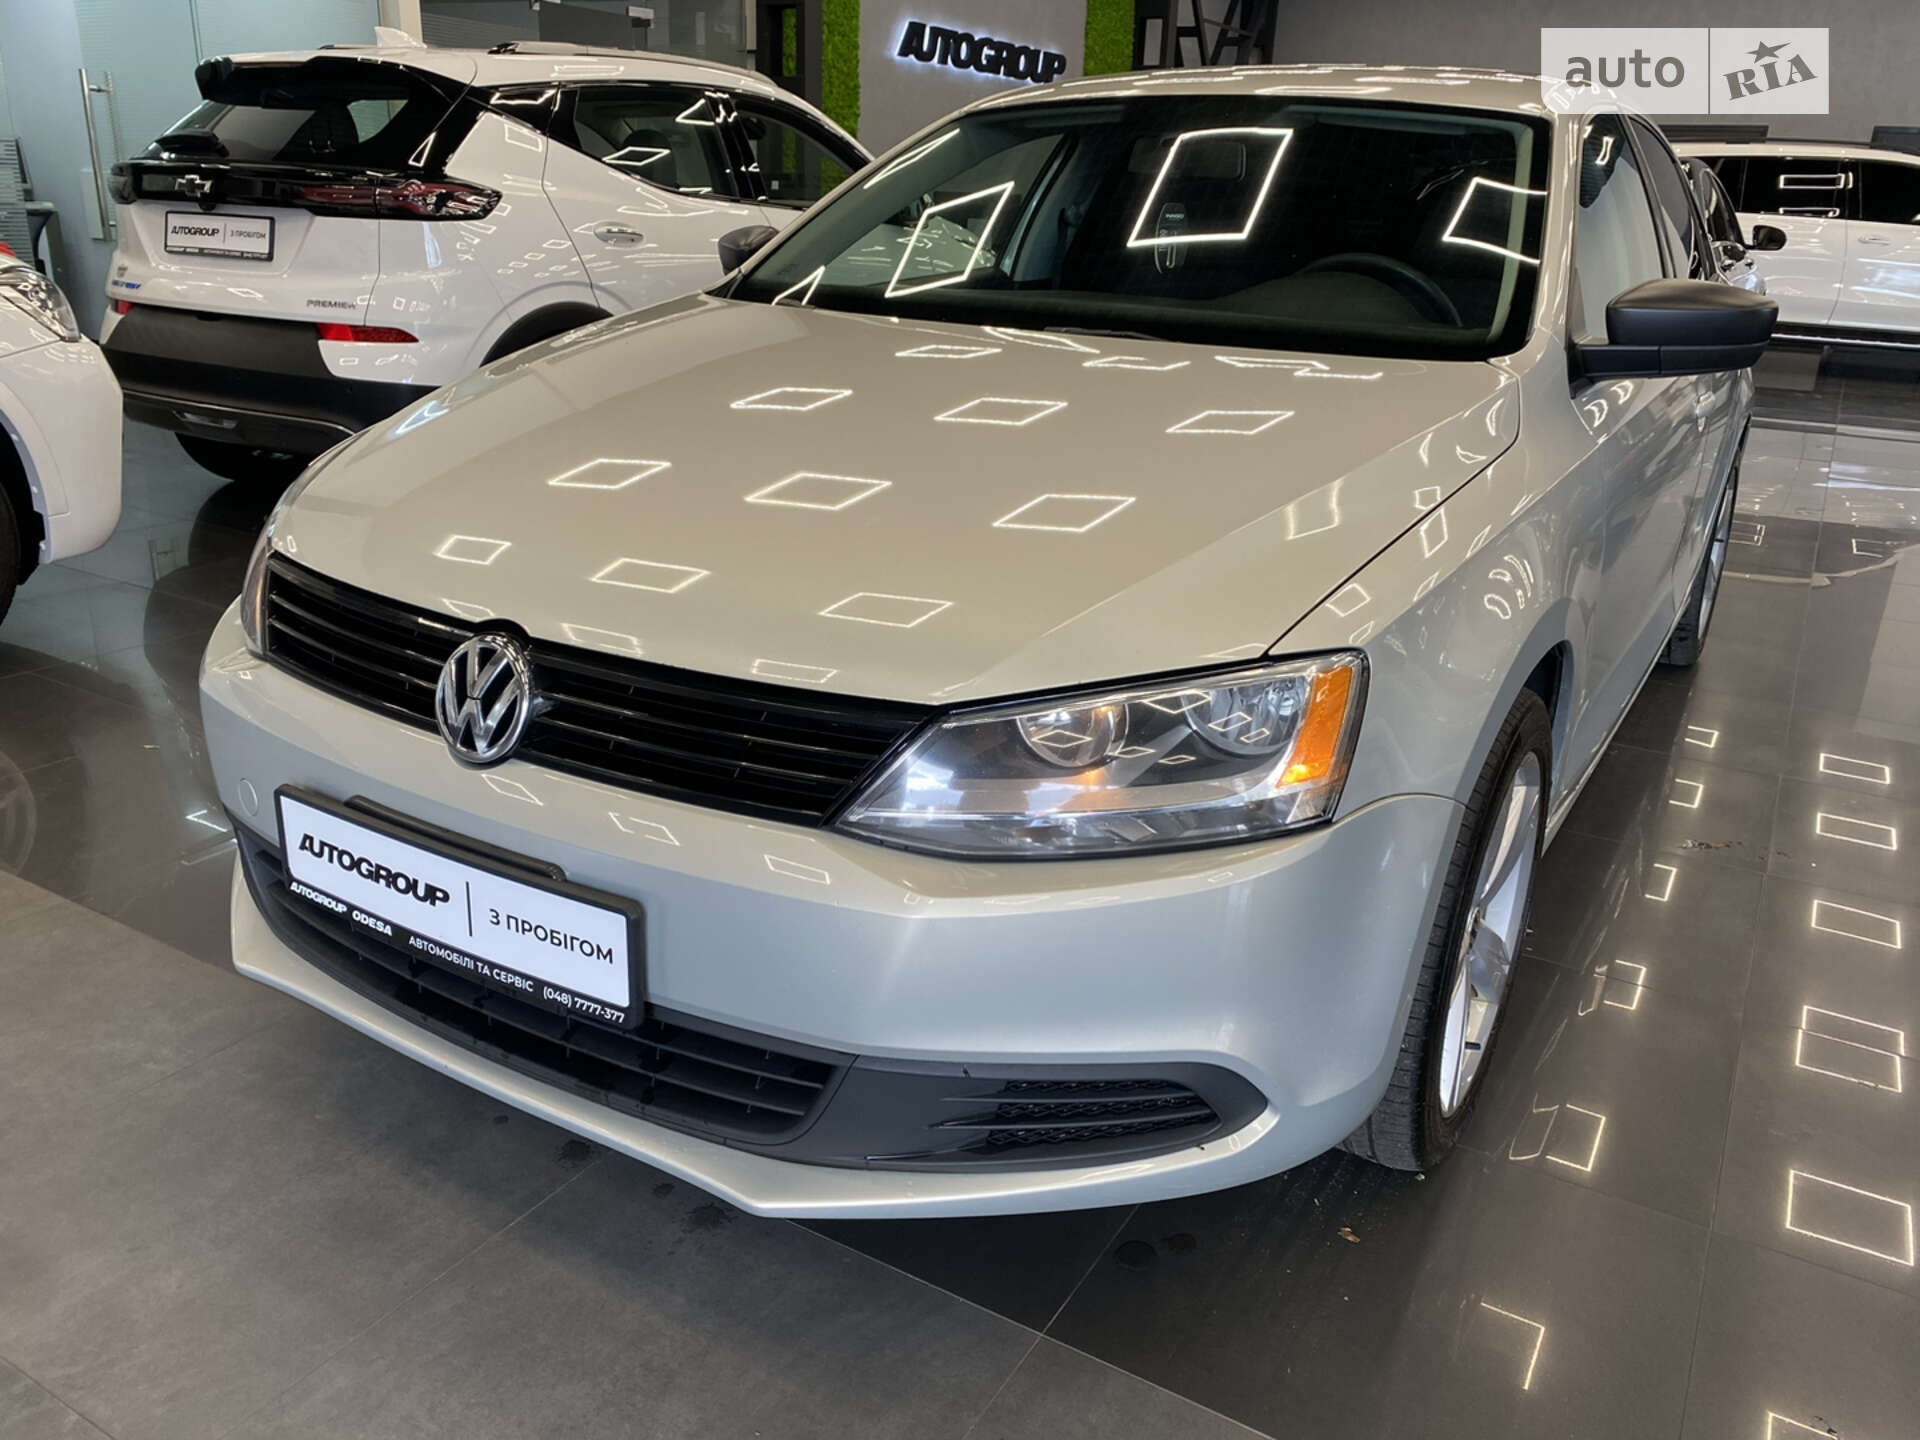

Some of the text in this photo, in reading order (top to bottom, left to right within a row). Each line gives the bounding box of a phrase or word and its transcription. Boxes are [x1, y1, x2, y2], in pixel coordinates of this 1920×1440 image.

[898, 21, 1067, 83] AUTOGROUP
[170, 225, 220, 237] AUTOGROUP
[298, 832, 451, 906] AUTOGROUP
[289, 881, 393, 936] AUTOGROUP ODESA
[408, 935, 535, 993] АВТОМОБІЛІ ТА СЕРВІС
[505, 914, 614, 964] ПРОБІГОМ
[542, 985, 626, 1024] (048) 7777-377
